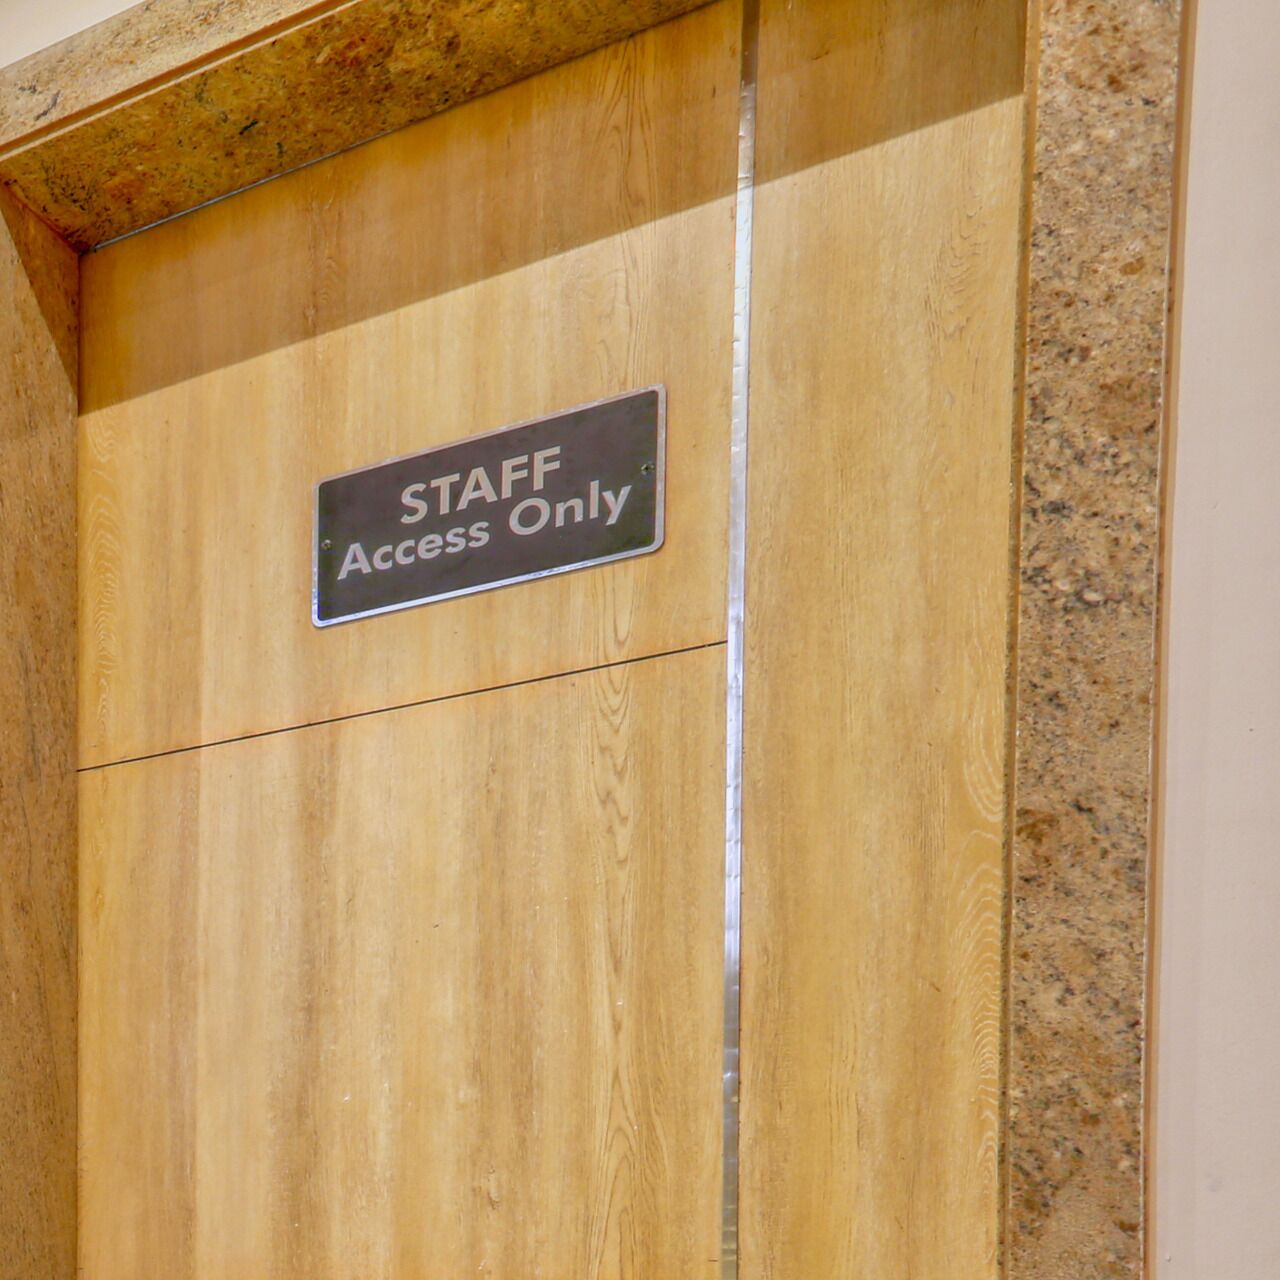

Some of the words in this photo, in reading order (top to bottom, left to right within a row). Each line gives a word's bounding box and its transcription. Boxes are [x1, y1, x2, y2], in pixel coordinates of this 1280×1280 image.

[400, 445, 562, 524] STAFF
[336, 520, 491, 581] Access
[508, 479, 634, 536] Only
